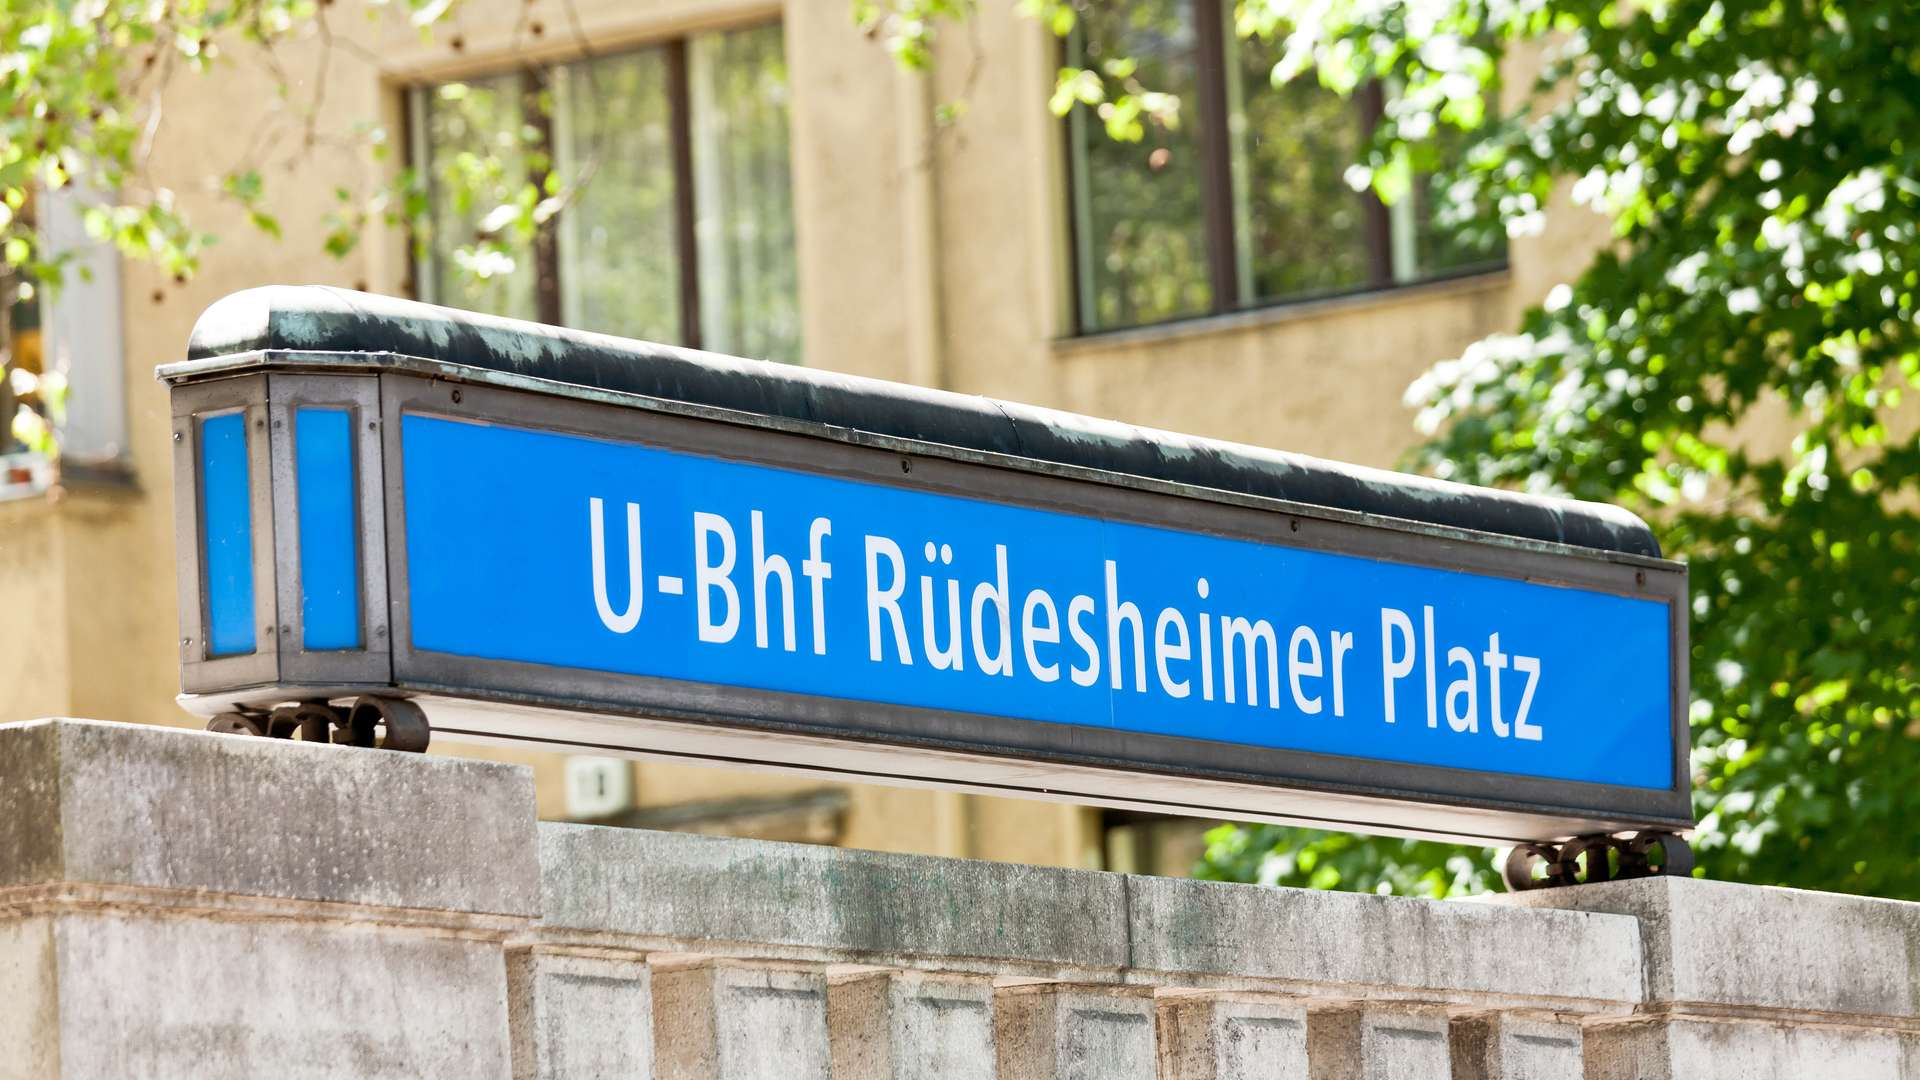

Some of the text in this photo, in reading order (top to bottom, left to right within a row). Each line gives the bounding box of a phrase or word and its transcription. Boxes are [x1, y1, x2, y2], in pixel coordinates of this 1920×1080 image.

[589, 497, 1544, 742] U-Bhf Rüdesheimer Platz
